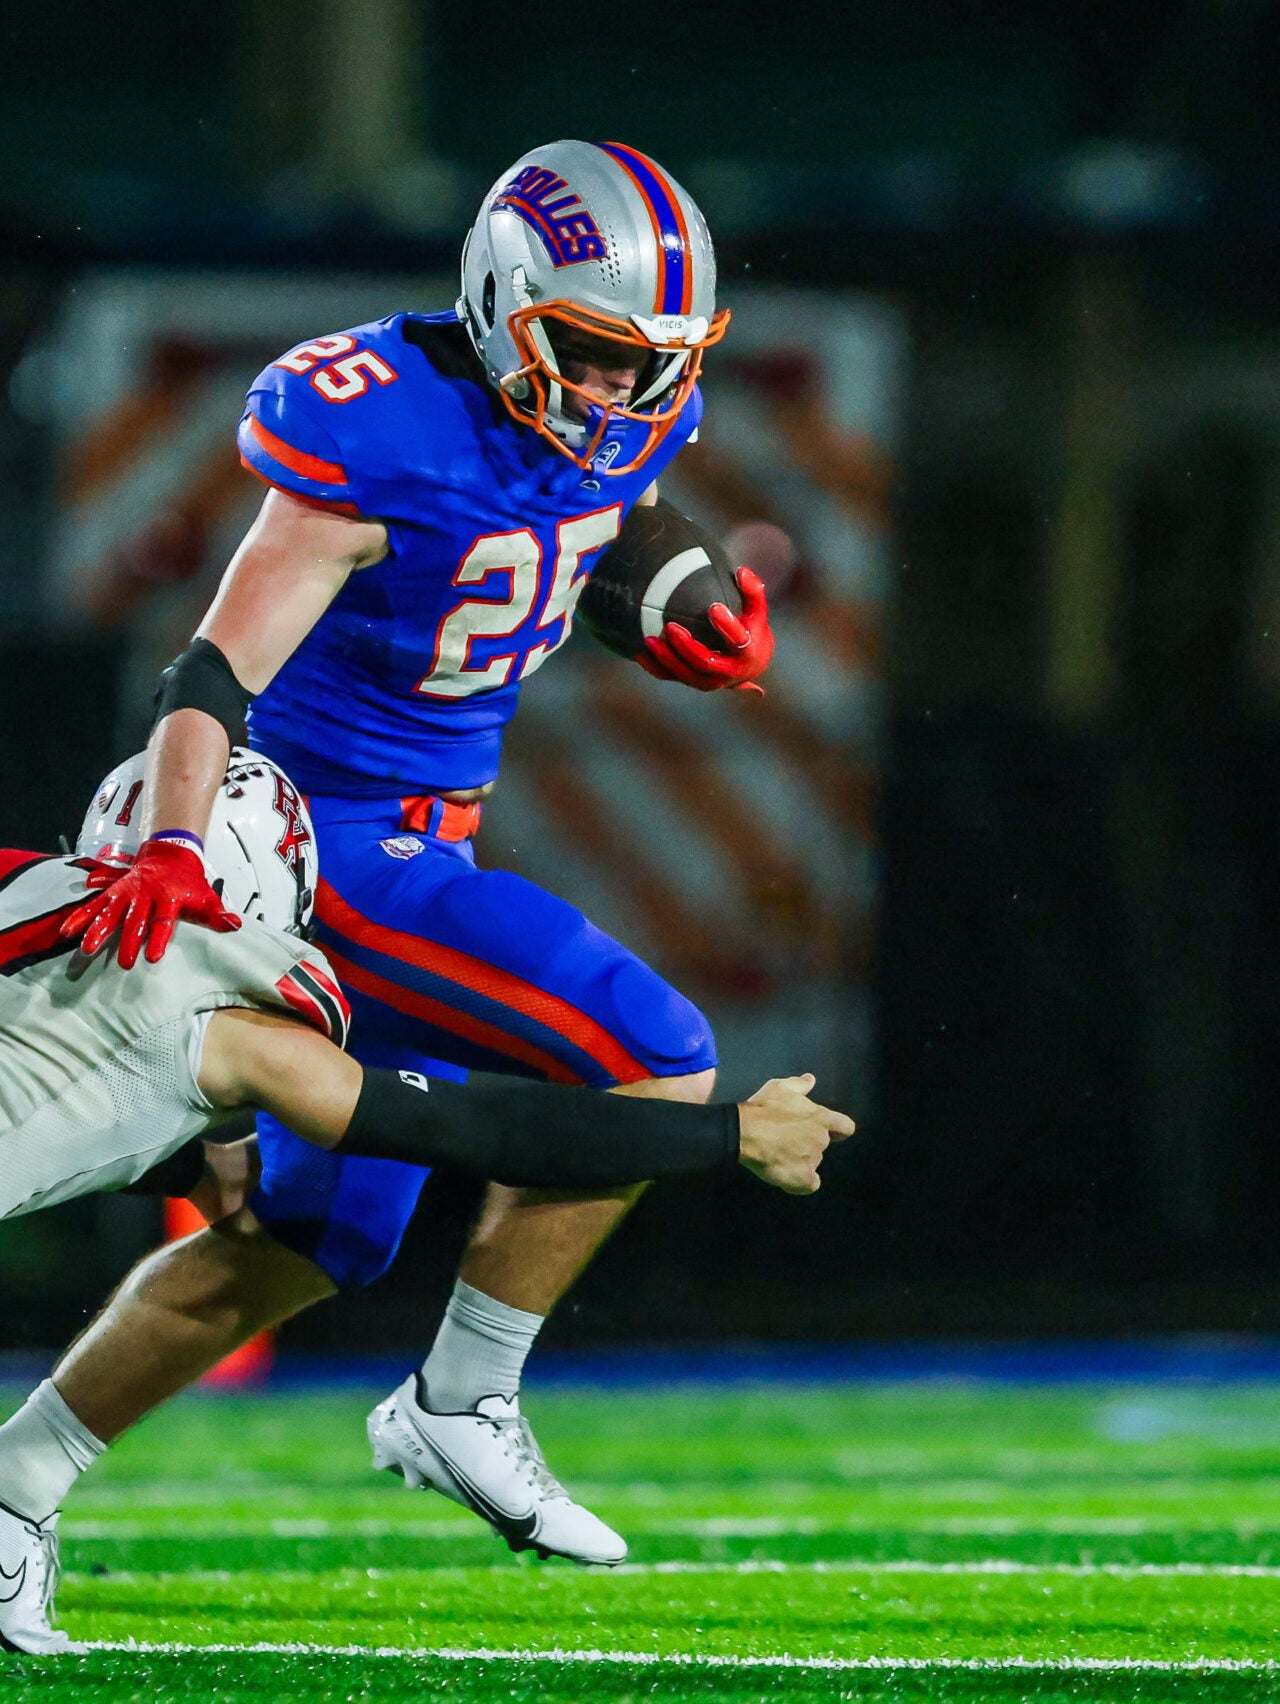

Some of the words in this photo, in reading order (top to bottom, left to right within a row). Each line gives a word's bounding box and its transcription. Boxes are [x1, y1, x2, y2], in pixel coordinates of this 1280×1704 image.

[658, 320, 683, 329] VICIS
[272, 333, 399, 404] 25
[411, 501, 623, 700] 25
